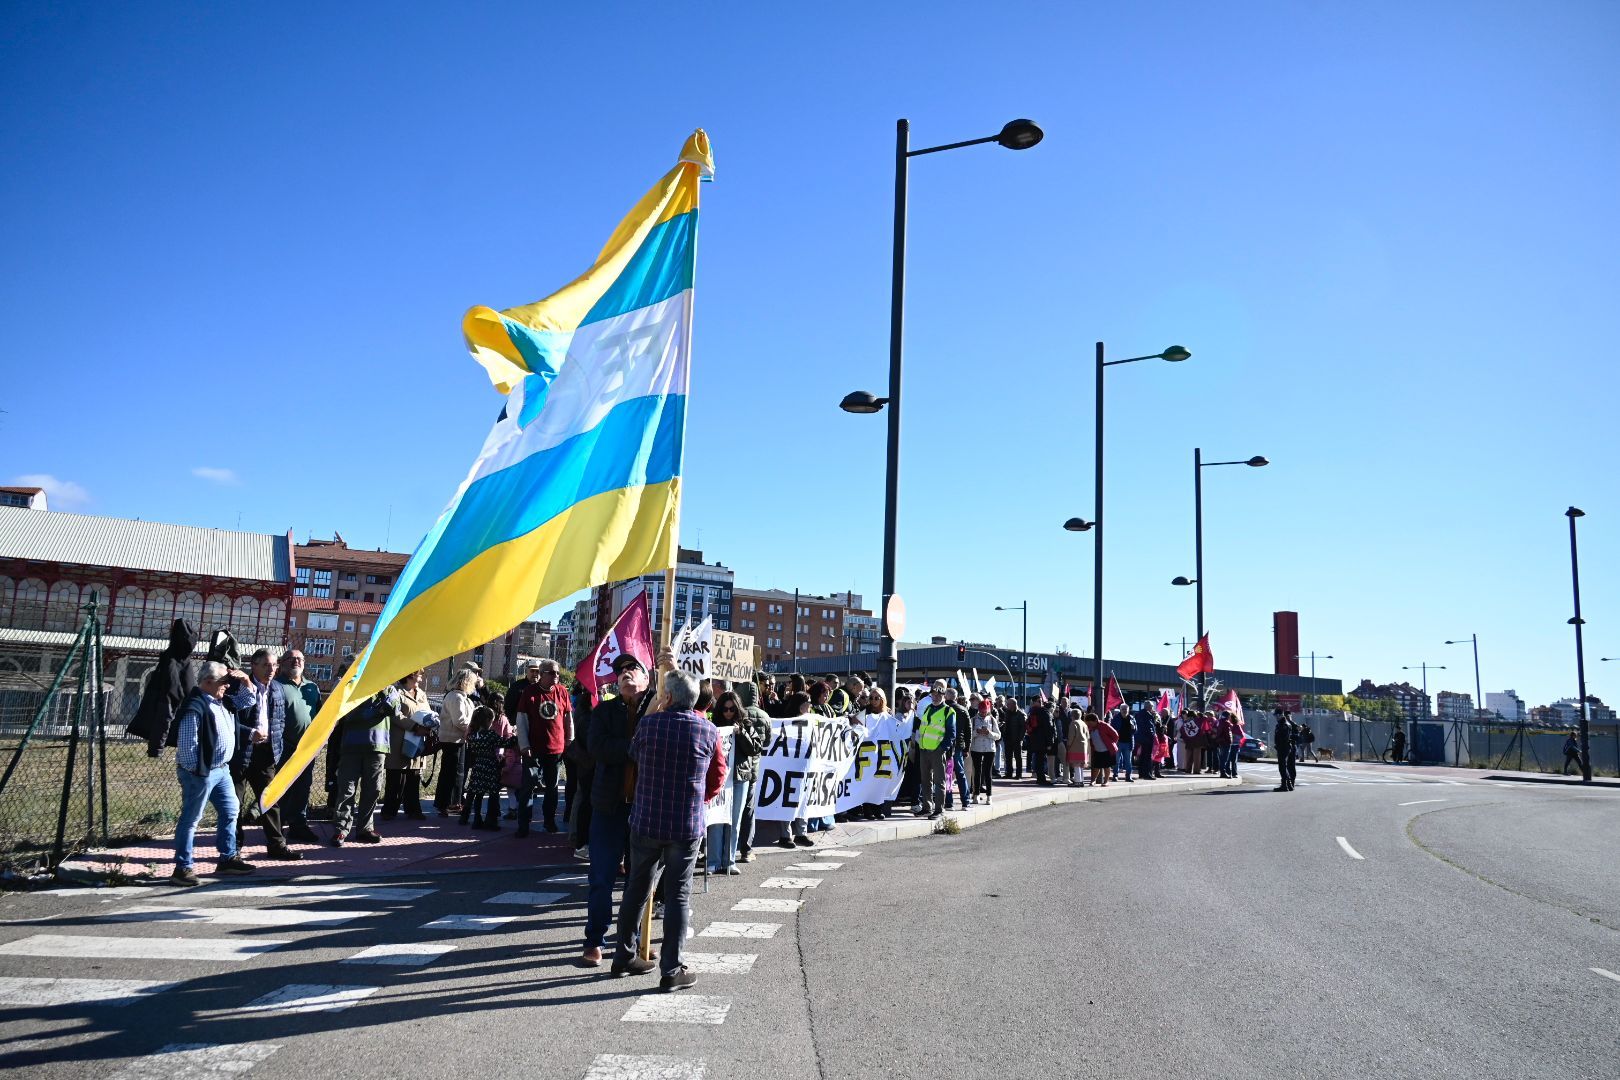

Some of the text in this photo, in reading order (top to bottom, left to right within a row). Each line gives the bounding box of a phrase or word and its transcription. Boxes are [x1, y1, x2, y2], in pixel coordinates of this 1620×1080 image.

[680, 640, 710, 655] ORAR
[714, 633, 750, 651] EL TREN
[715, 648, 737, 661] A LA
[712, 660, 753, 680] ESTACIÓN
[837, 778, 852, 799] DE
[855, 740, 910, 782] FEV
